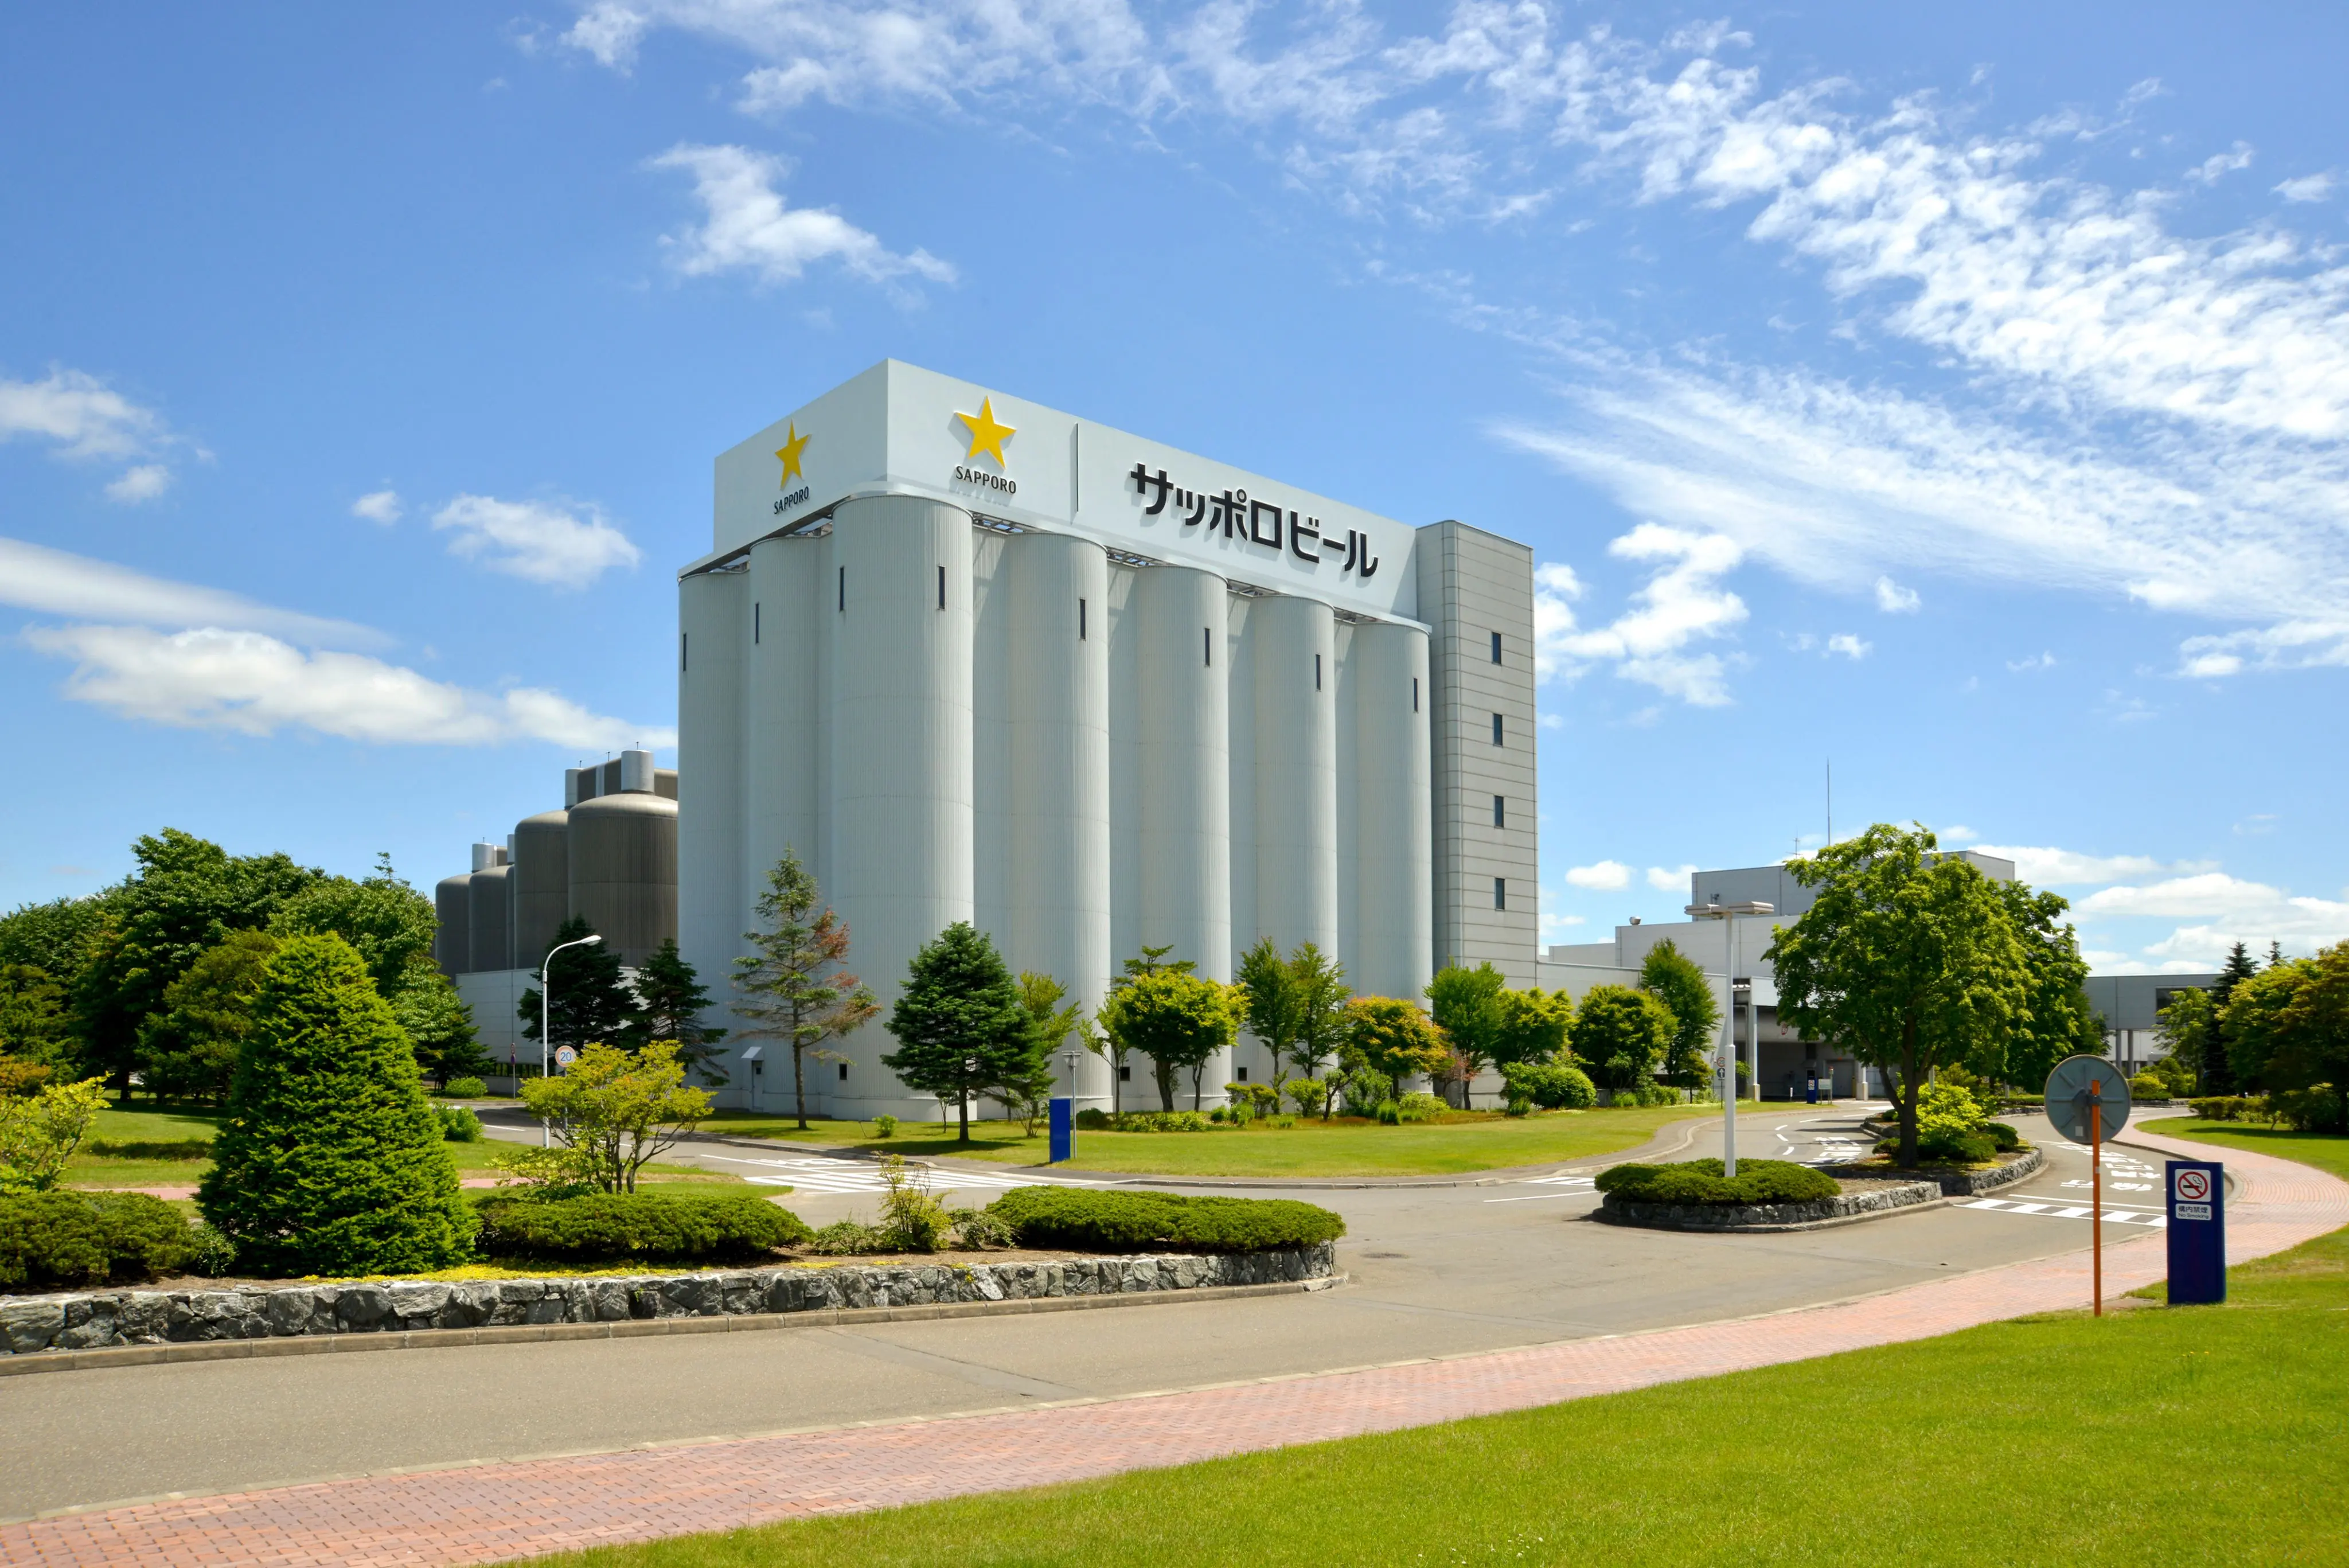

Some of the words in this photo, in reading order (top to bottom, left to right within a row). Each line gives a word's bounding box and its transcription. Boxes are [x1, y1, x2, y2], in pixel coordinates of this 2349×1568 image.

[957, 465, 1017, 494] SAPPORO
[774, 486, 809, 515] SAPPORO
[1130, 463, 1379, 577] サッポロビール
[560, 1052, 572, 1061] 20
